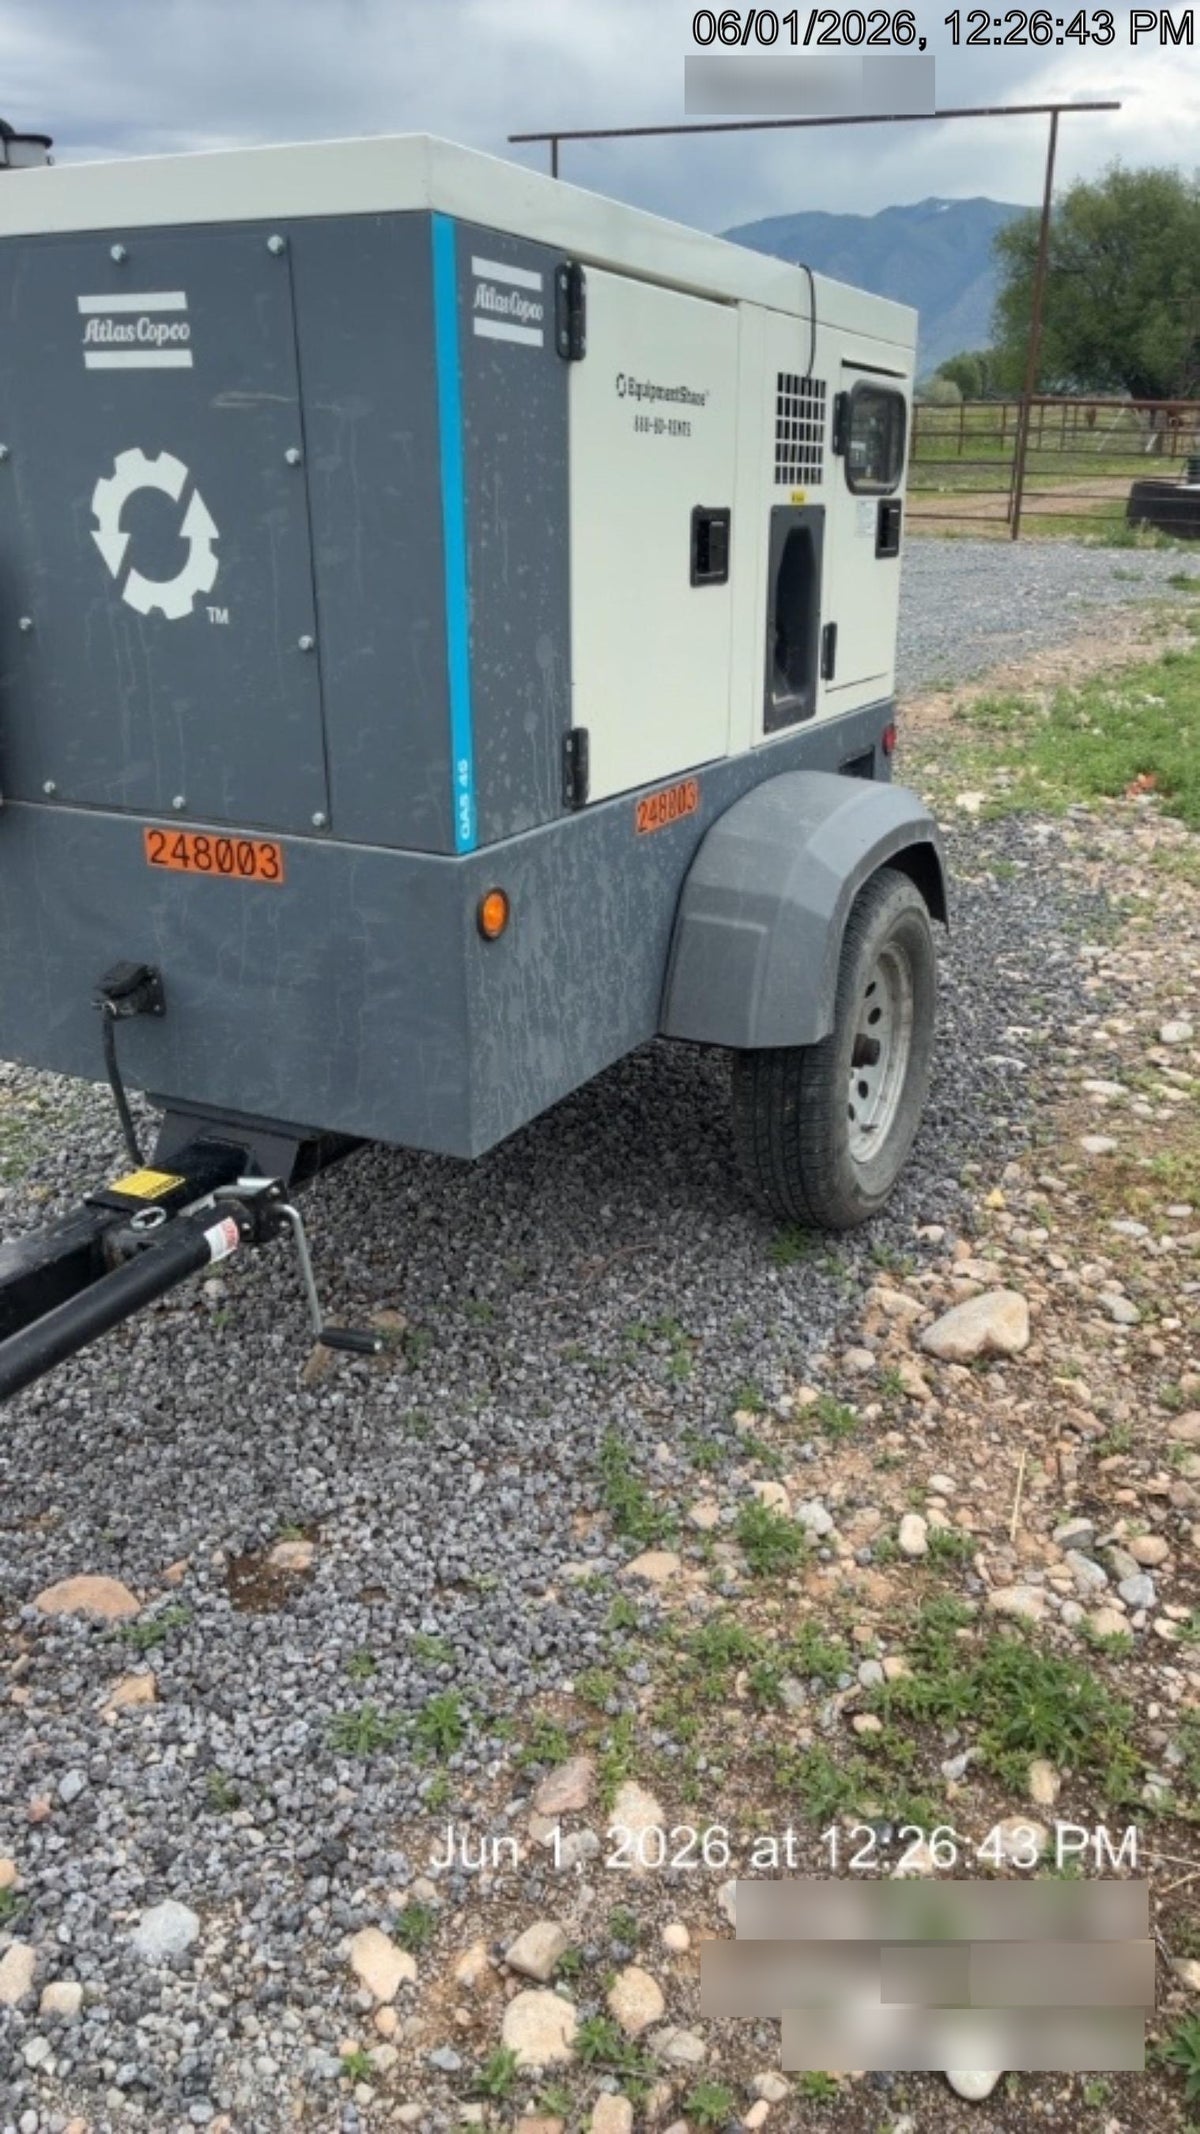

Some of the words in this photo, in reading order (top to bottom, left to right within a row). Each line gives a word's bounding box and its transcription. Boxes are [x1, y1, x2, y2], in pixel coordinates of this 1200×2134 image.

[473, 283, 511, 314] Atlas
[511, 291, 543, 322] Copco
[82, 318, 136, 344] Atlas
[136, 317, 191, 347] Copco
[205, 606, 229, 625] TM
[637, 781, 697, 833] 248003
[148, 829, 279, 879] 248003
